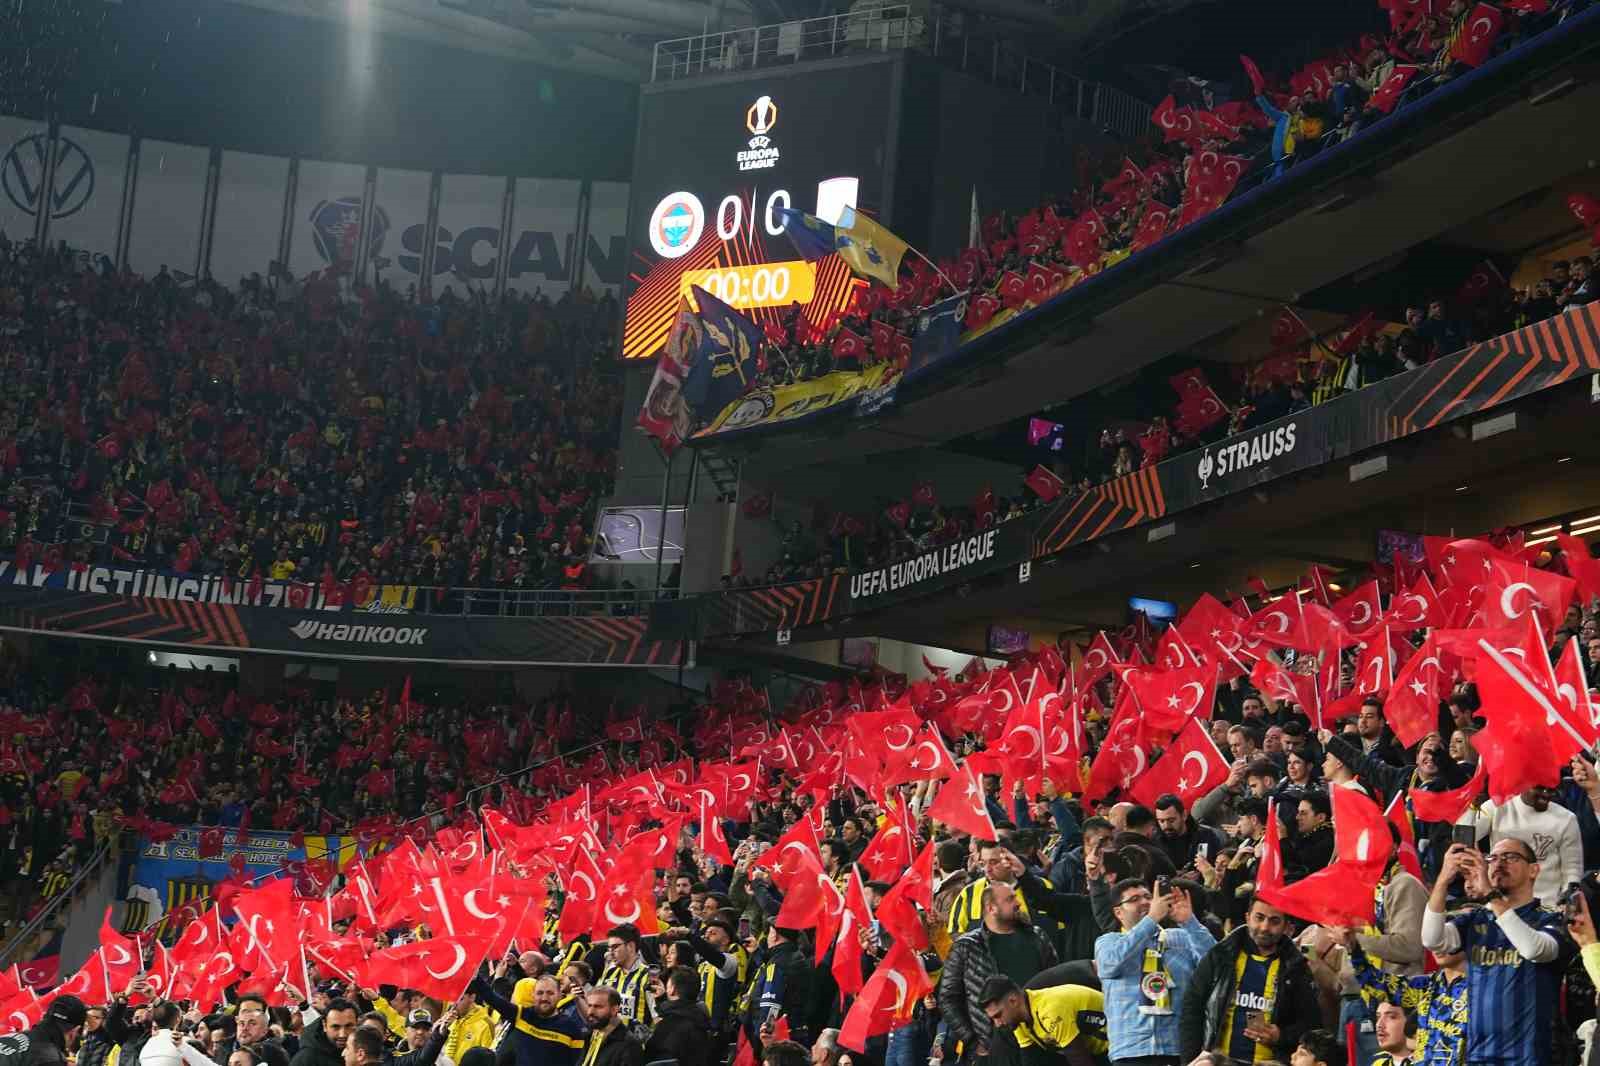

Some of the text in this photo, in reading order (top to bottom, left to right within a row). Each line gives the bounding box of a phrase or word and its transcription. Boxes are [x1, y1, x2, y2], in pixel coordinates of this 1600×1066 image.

[737, 147, 780, 161] EUROPA
[739, 158, 778, 170] LEAGUE
[717, 189, 791, 240] 0 0
[704, 267, 790, 305] 00:00
[1216, 422, 1297, 477] STRAUSS
[850, 530, 996, 599] UEFA EUROPA LEAGUE
[1235, 990, 1273, 1011] toko
